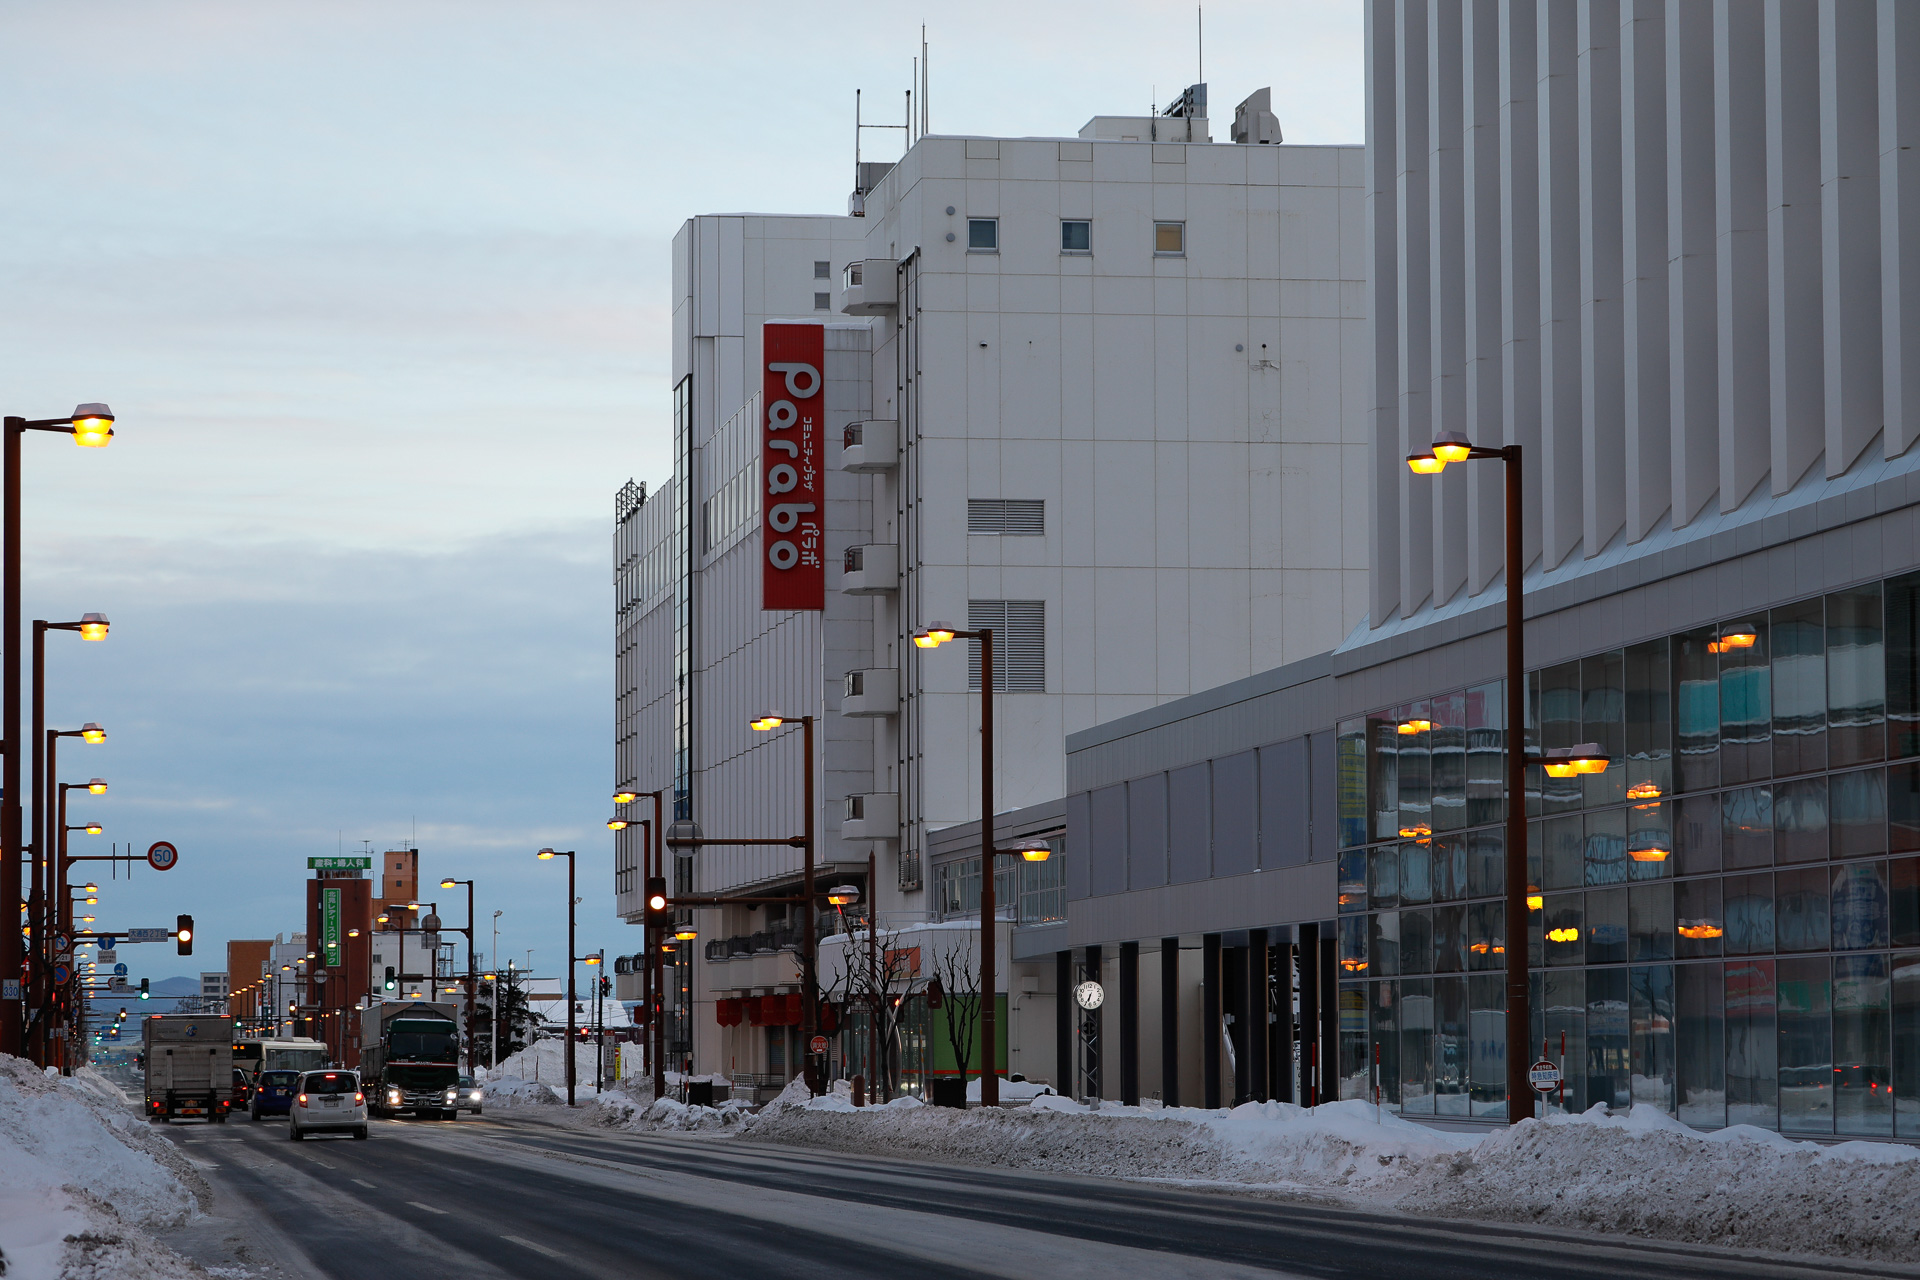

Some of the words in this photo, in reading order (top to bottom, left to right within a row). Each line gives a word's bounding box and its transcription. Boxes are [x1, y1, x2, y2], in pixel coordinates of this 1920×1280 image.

[768, 362, 821, 570] Parabo
[803, 417, 816, 492] コミュニティプラザ
[801, 522, 820, 569] パラボ
[154, 849, 171, 863] 50
[314, 858, 365, 868] 産科・婦人科
[328, 891, 337, 964] 北見レディースクニック
[3, 986, 18, 997] 330
